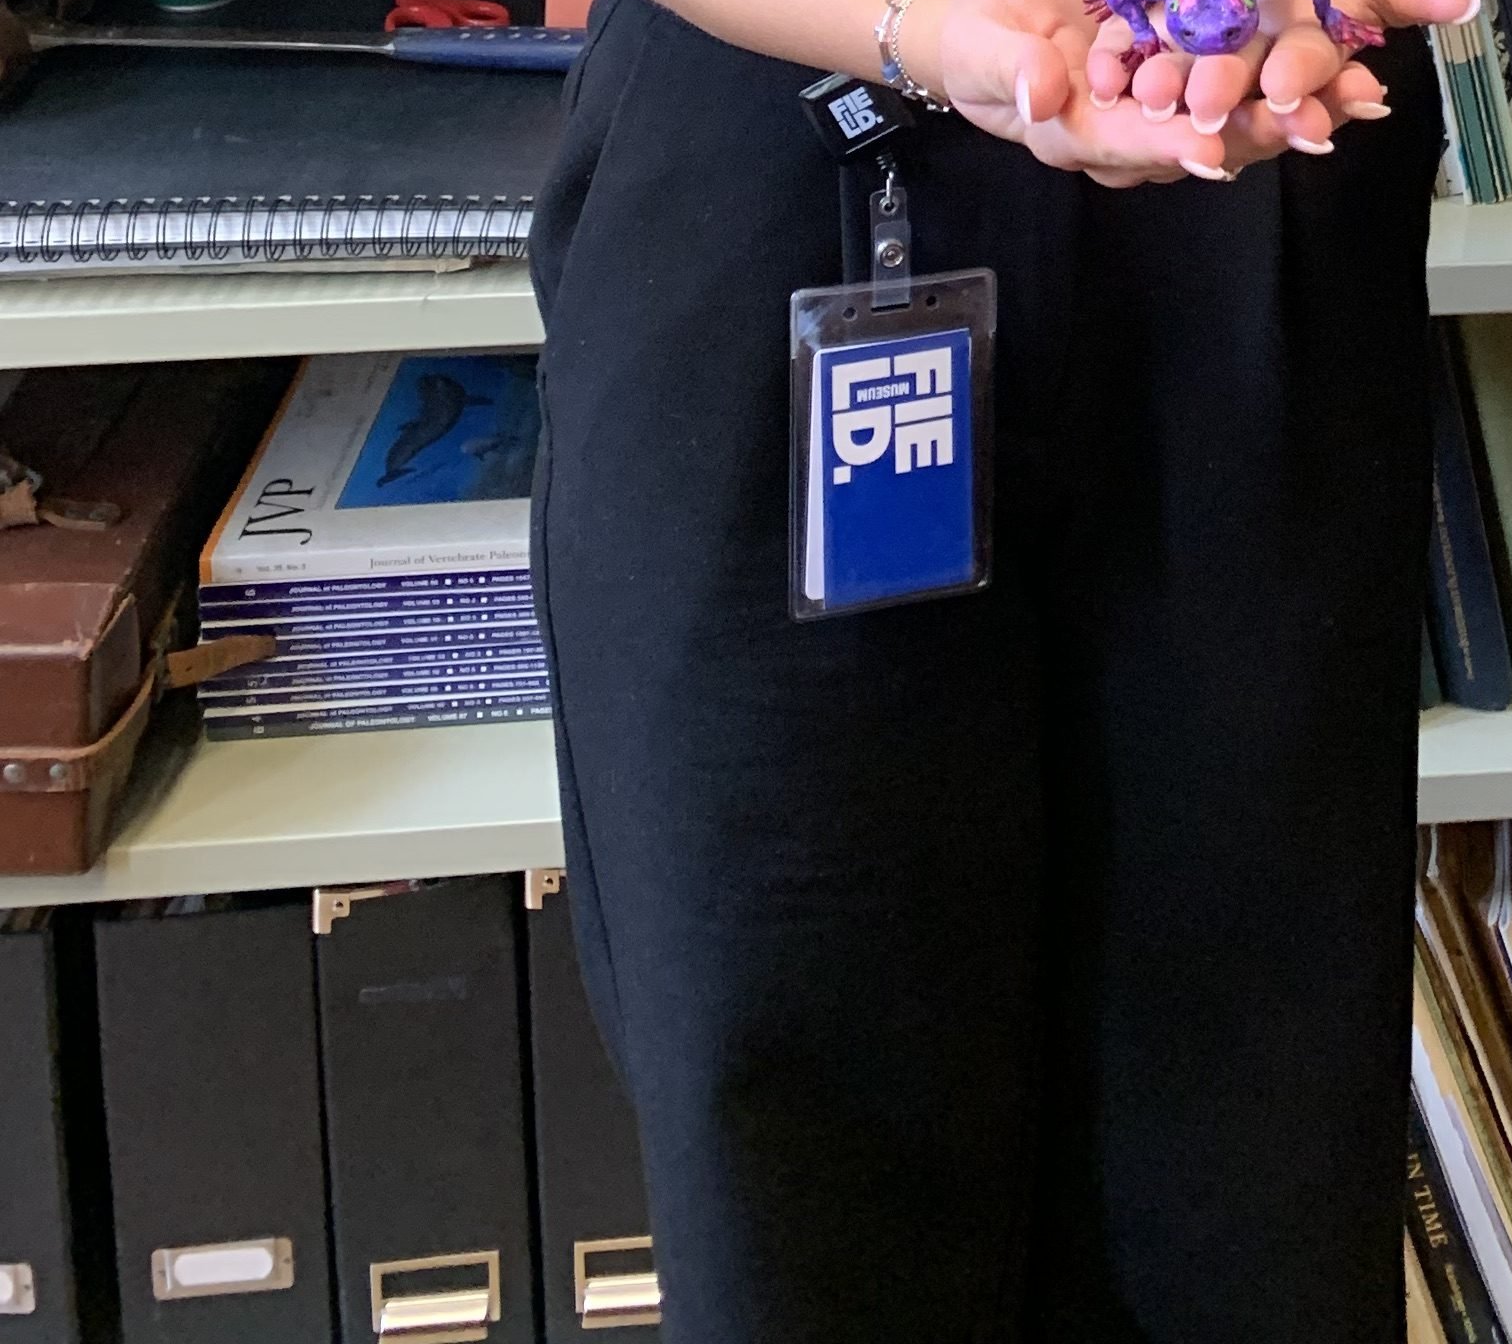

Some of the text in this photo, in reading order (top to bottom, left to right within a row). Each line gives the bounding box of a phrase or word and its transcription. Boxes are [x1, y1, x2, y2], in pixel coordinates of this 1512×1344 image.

[856, 381, 911, 403] MUSEUM
[237, 476, 317, 546] JVP
[368, 550, 486, 570] Journal of Vertebrate
[289, 582, 388, 596] JOURNAL PALEONTOLOGY
[291, 604, 324, 614] JOURNAL
[333, 600, 389, 611] PALEONTOLOGY
[308, 715, 417, 732] JOURNAL PALEONTOLOGY
[1414, 1184, 1449, 1249] TIME
